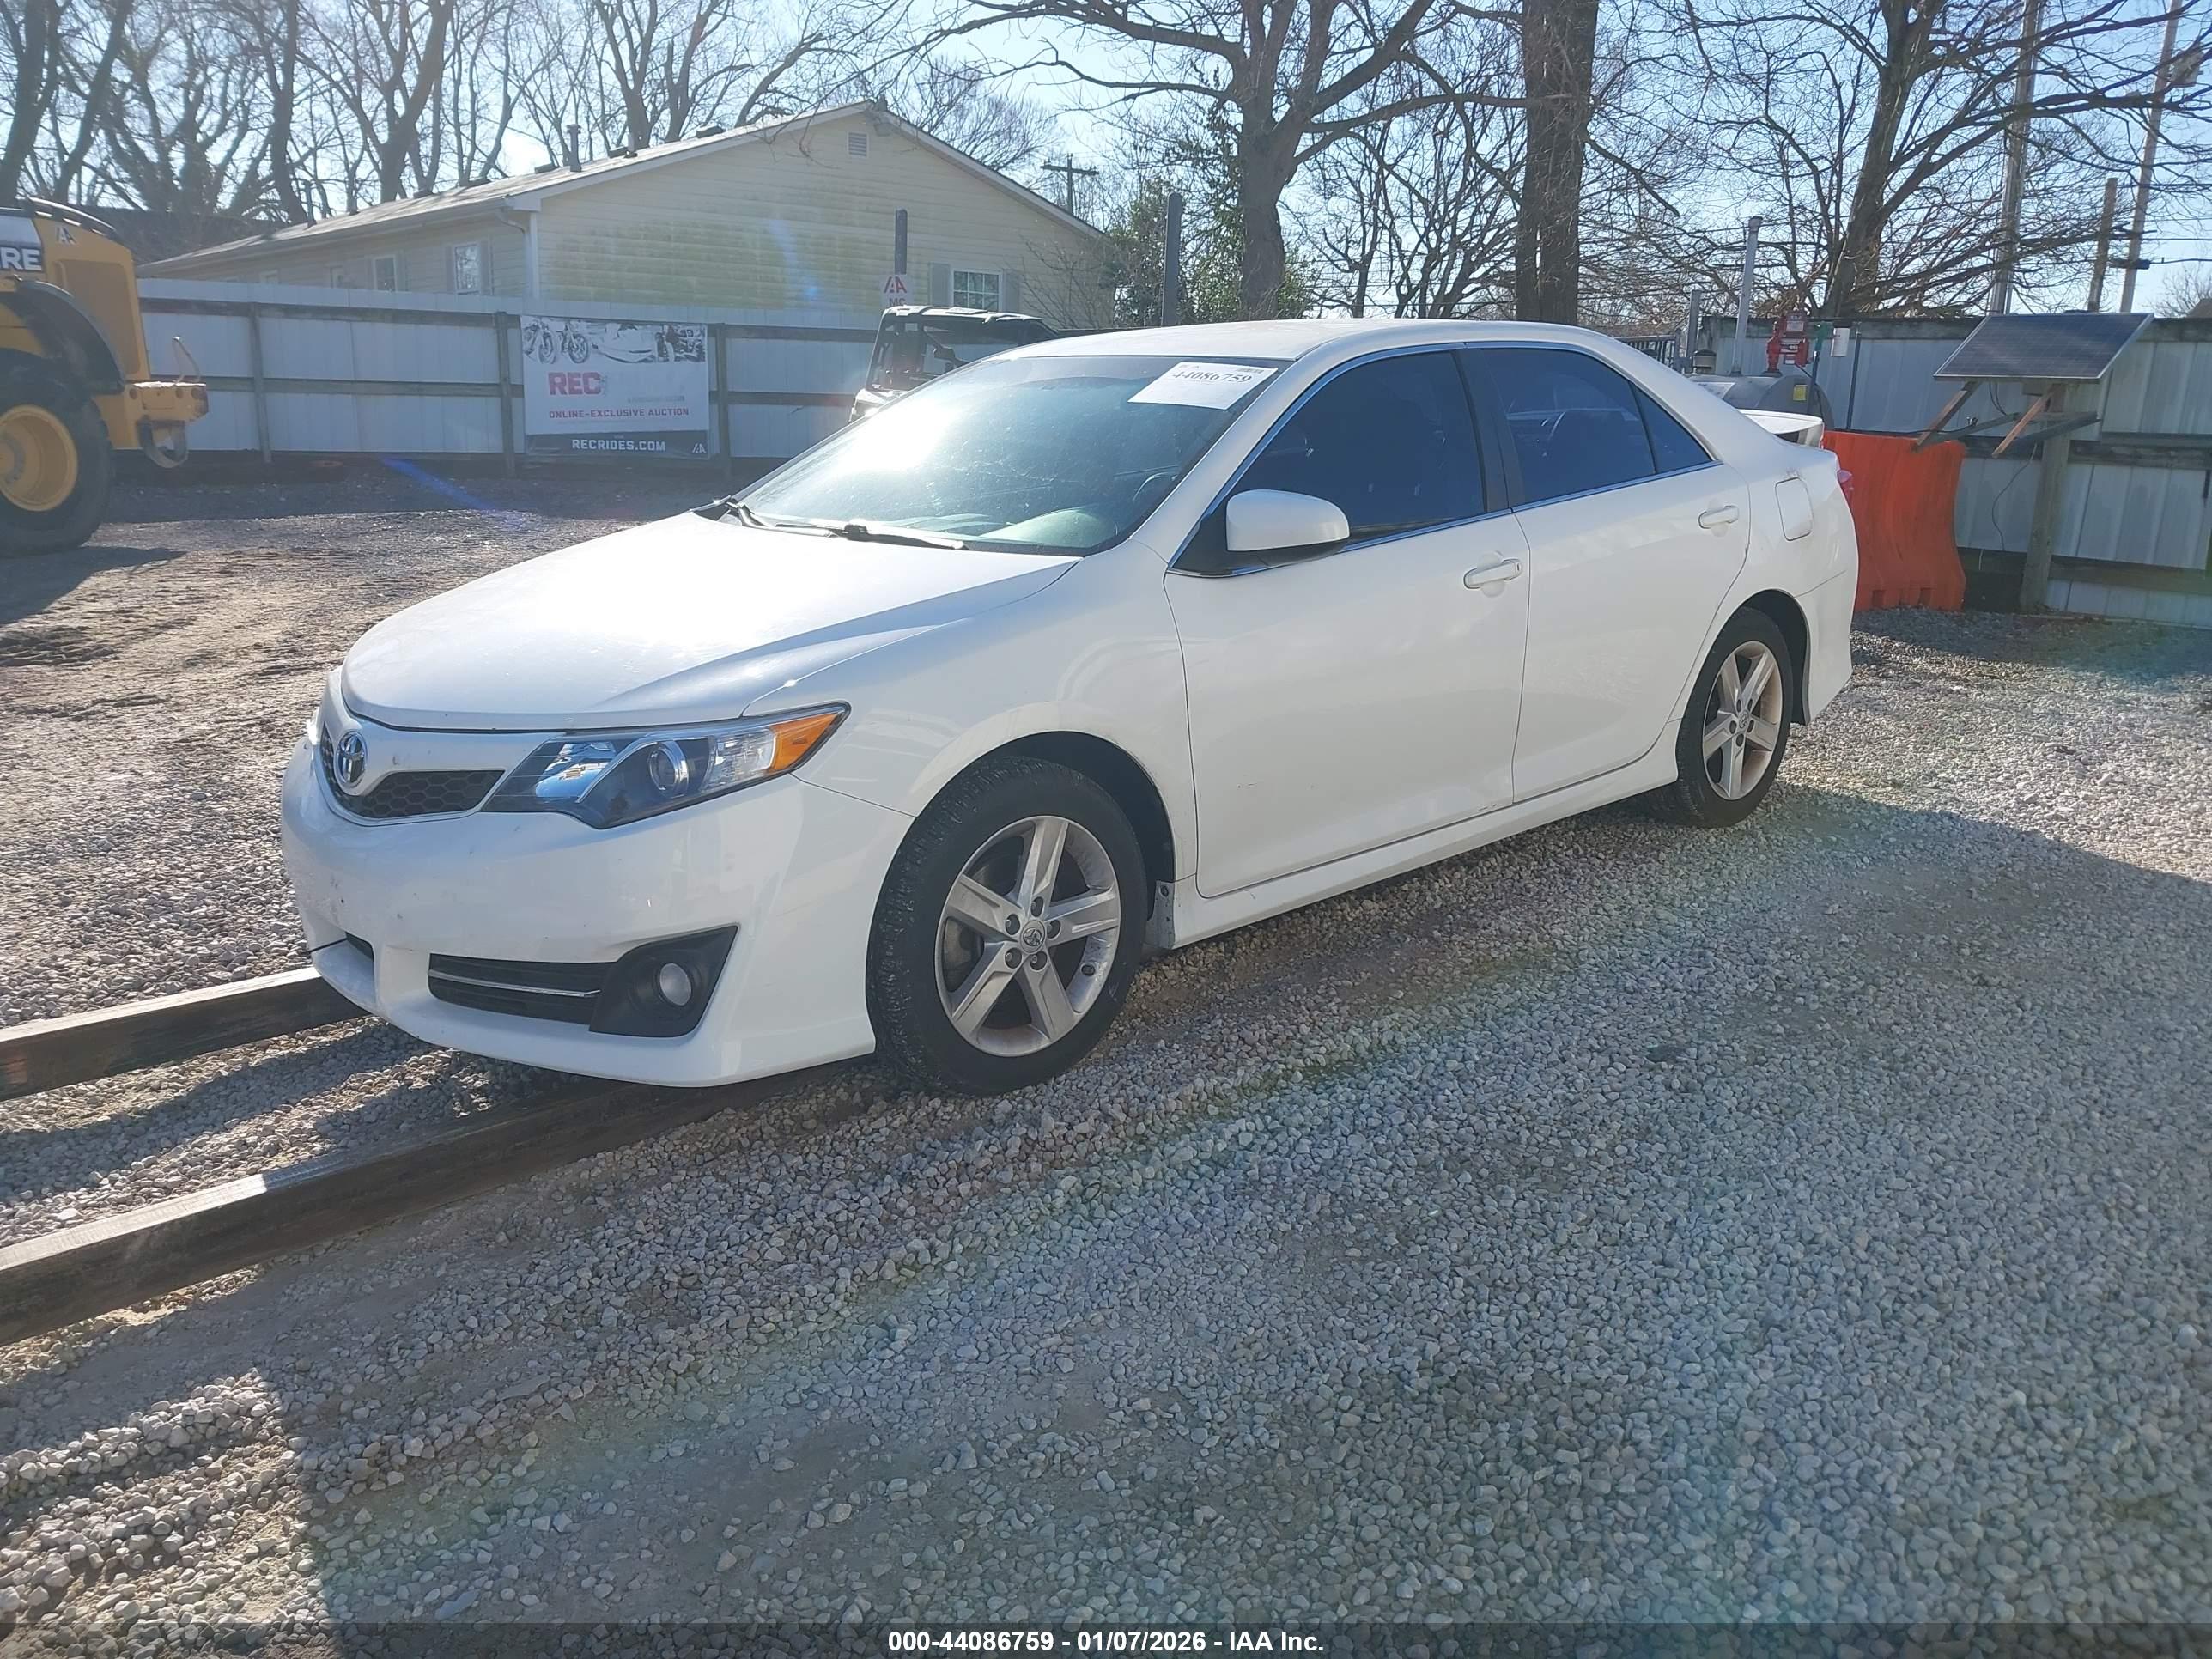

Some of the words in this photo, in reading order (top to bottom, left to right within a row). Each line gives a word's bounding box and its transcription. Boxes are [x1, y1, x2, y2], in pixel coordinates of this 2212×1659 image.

[1172, 370, 1252, 383] 44086759
[549, 408, 646, 419] ONLINE-EXCLUSIVE
[648, 407, 690, 416] AUCTION
[571, 439, 666, 452] RECRIDES.COM
